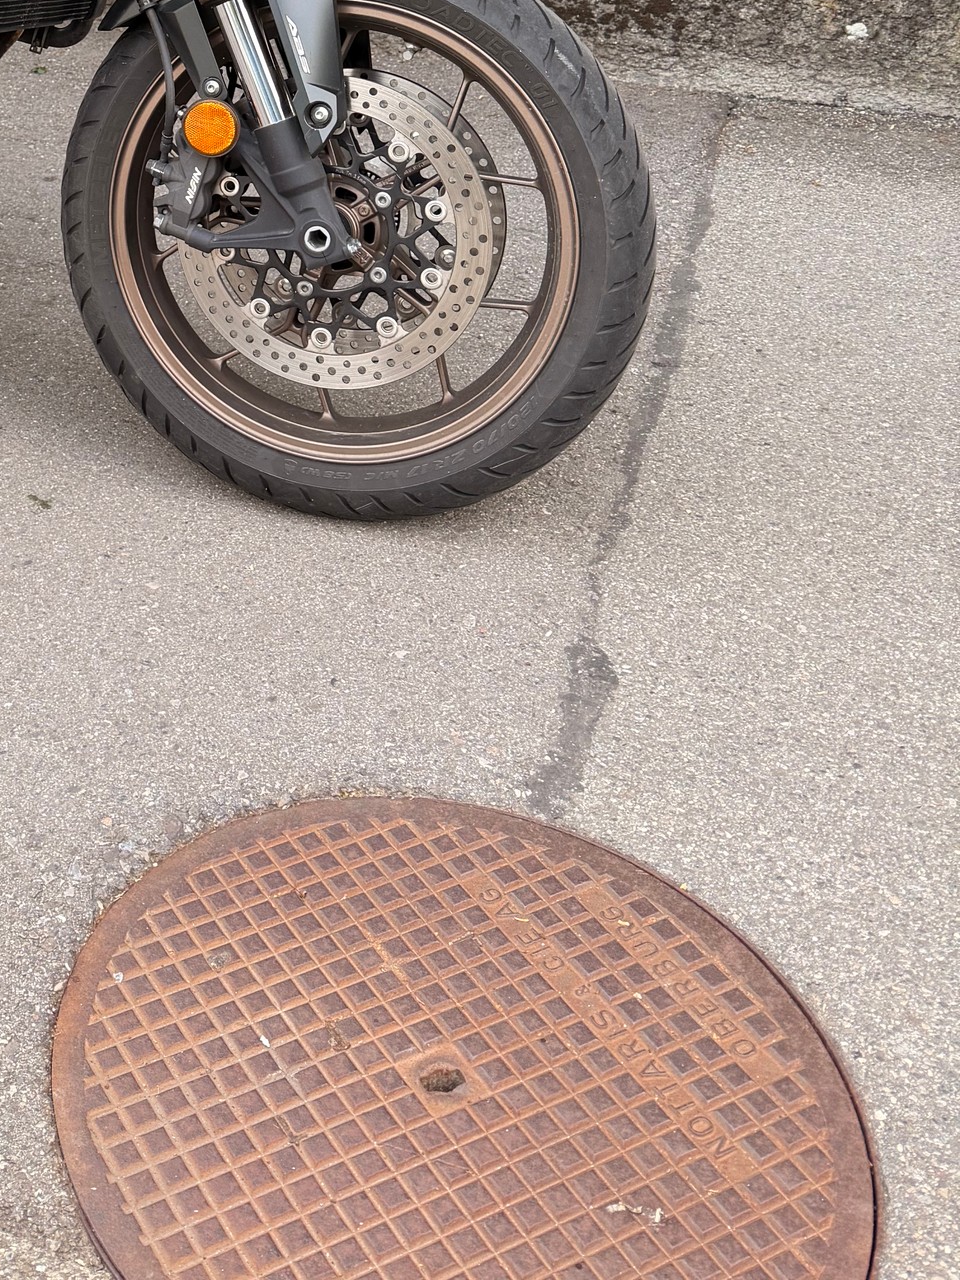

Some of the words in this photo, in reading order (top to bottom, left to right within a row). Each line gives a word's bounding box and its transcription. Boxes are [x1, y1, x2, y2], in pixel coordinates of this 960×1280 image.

[285, 15, 310, 74] ABS
[479, 888, 523, 919] AG
[516, 927, 565, 971] CIE
[575, 983, 592, 997] &
[599, 906, 757, 1059] OBERBURG
[589, 1009, 738, 1159] NOTTARIS
